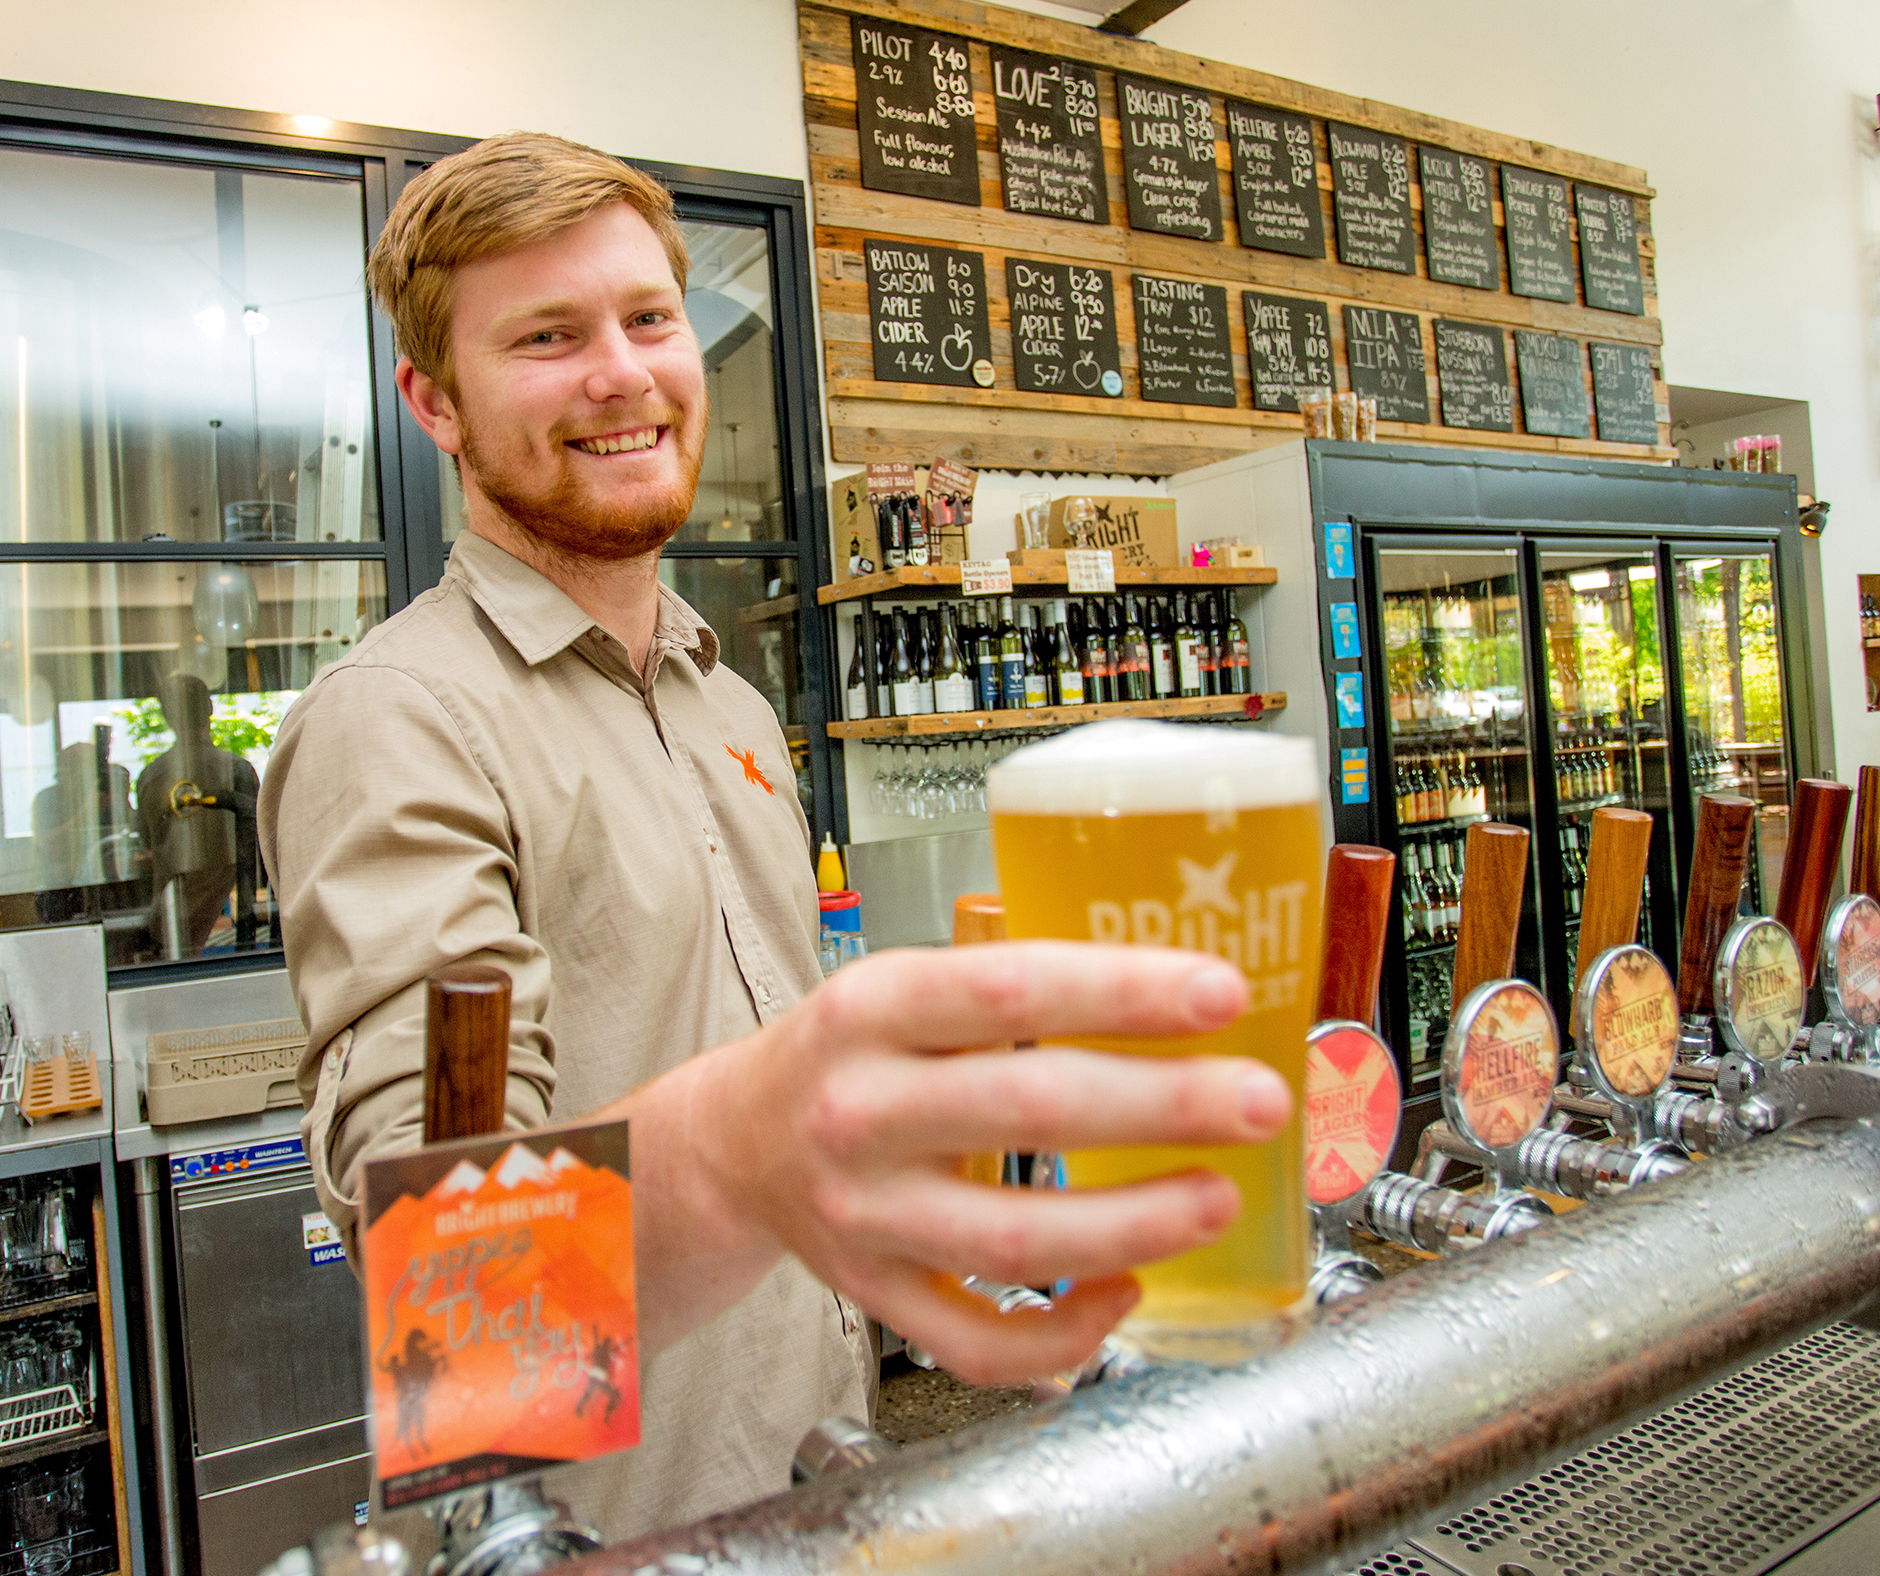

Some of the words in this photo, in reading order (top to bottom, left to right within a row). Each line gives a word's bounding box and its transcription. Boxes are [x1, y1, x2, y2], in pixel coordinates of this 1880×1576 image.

[860, 29, 912, 61] PILOT
[877, 96, 926, 123] Session
[928, 107, 950, 129] Ale
[1125, 84, 1178, 119] BRIGHT
[1131, 121, 1182, 149] LAGER
[1229, 111, 1279, 142] HELLFIRE
[874, 130, 901, 151] Full
[1238, 139, 1275, 160] AMBER
[1330, 133, 1379, 161] BLOWHARD
[882, 149, 904, 168] low
[910, 156, 950, 175] alcohol
[1074, 149, 1094, 171] Ale
[1341, 161, 1368, 179] PALE
[1071, 184, 1083, 203] &
[1274, 180, 1289, 194] Ale
[1009, 190, 1039, 211] Equal
[1042, 196, 1061, 212] love
[1063, 200, 1077, 215] for
[1079, 204, 1094, 220] all
[1254, 197, 1272, 212] Full
[1508, 196, 1538, 216] PORTER
[1157, 208, 1211, 237] refreshing
[870, 249, 930, 272] BATLOW
[878, 273, 935, 294] SAISON
[1015, 265, 1055, 295] Dry
[1138, 276, 1204, 302] TASTING
[880, 296, 922, 318] APPLE
[1138, 297, 1173, 319] TRAY
[1188, 305, 1214, 328] $12
[878, 320, 929, 344] CIDER
[1019, 315, 1065, 341] APPLE
[1351, 309, 1400, 343] MIA
[1409, 327, 1420, 346] 9
[1022, 339, 1064, 359] CIDER
[1437, 324, 1494, 356] STUBBORN
[1438, 347, 1482, 375] RUSSIAN
[872, 463, 891, 473] Join
[893, 464, 908, 472] the
[984, 578, 1010, 590] $3.90
[1747, 966, 1785, 1002] RAZOR
[1604, 998, 1662, 1041] BLOWHARD
[1473, 1038, 1541, 1081] HELLFIRE
[1313, 1114, 1361, 1136] LAGER
